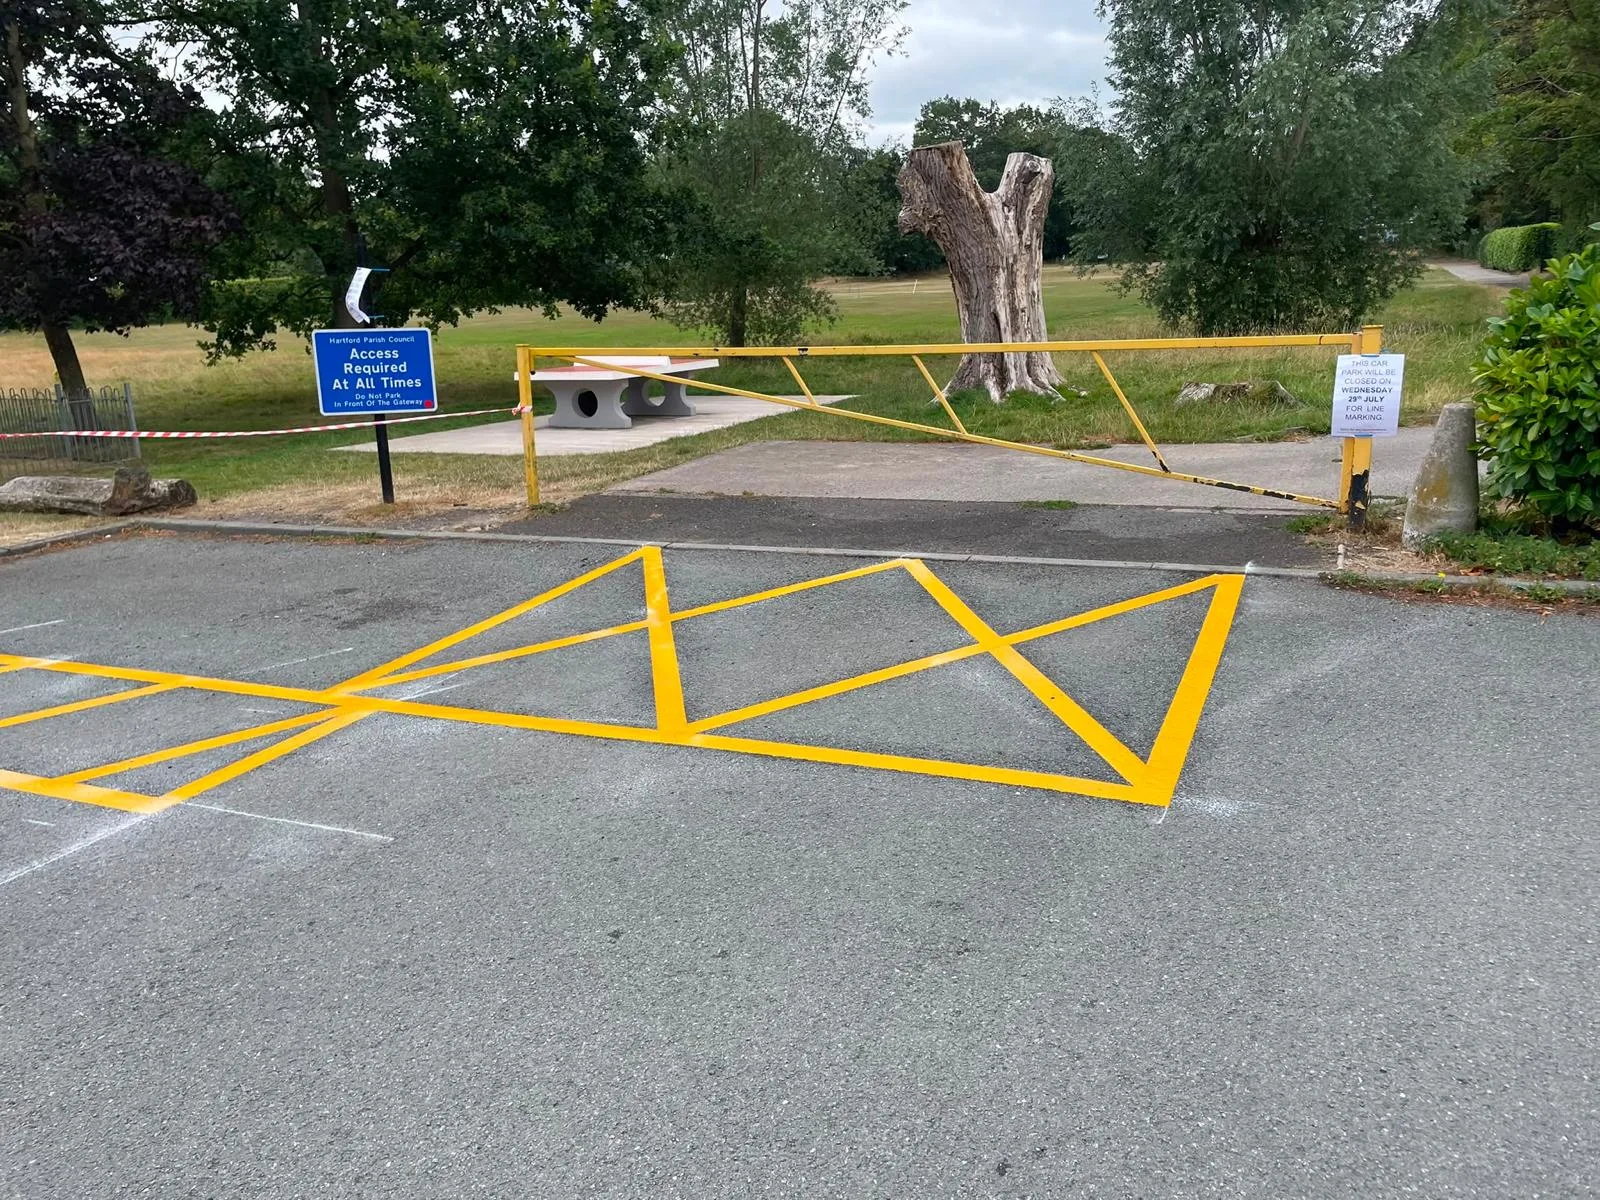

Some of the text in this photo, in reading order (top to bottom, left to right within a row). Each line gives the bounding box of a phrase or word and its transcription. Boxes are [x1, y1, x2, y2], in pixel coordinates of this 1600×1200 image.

[350, 348, 399, 360] Access
[344, 362, 407, 375] Required
[332, 377, 421, 390] At All Times
